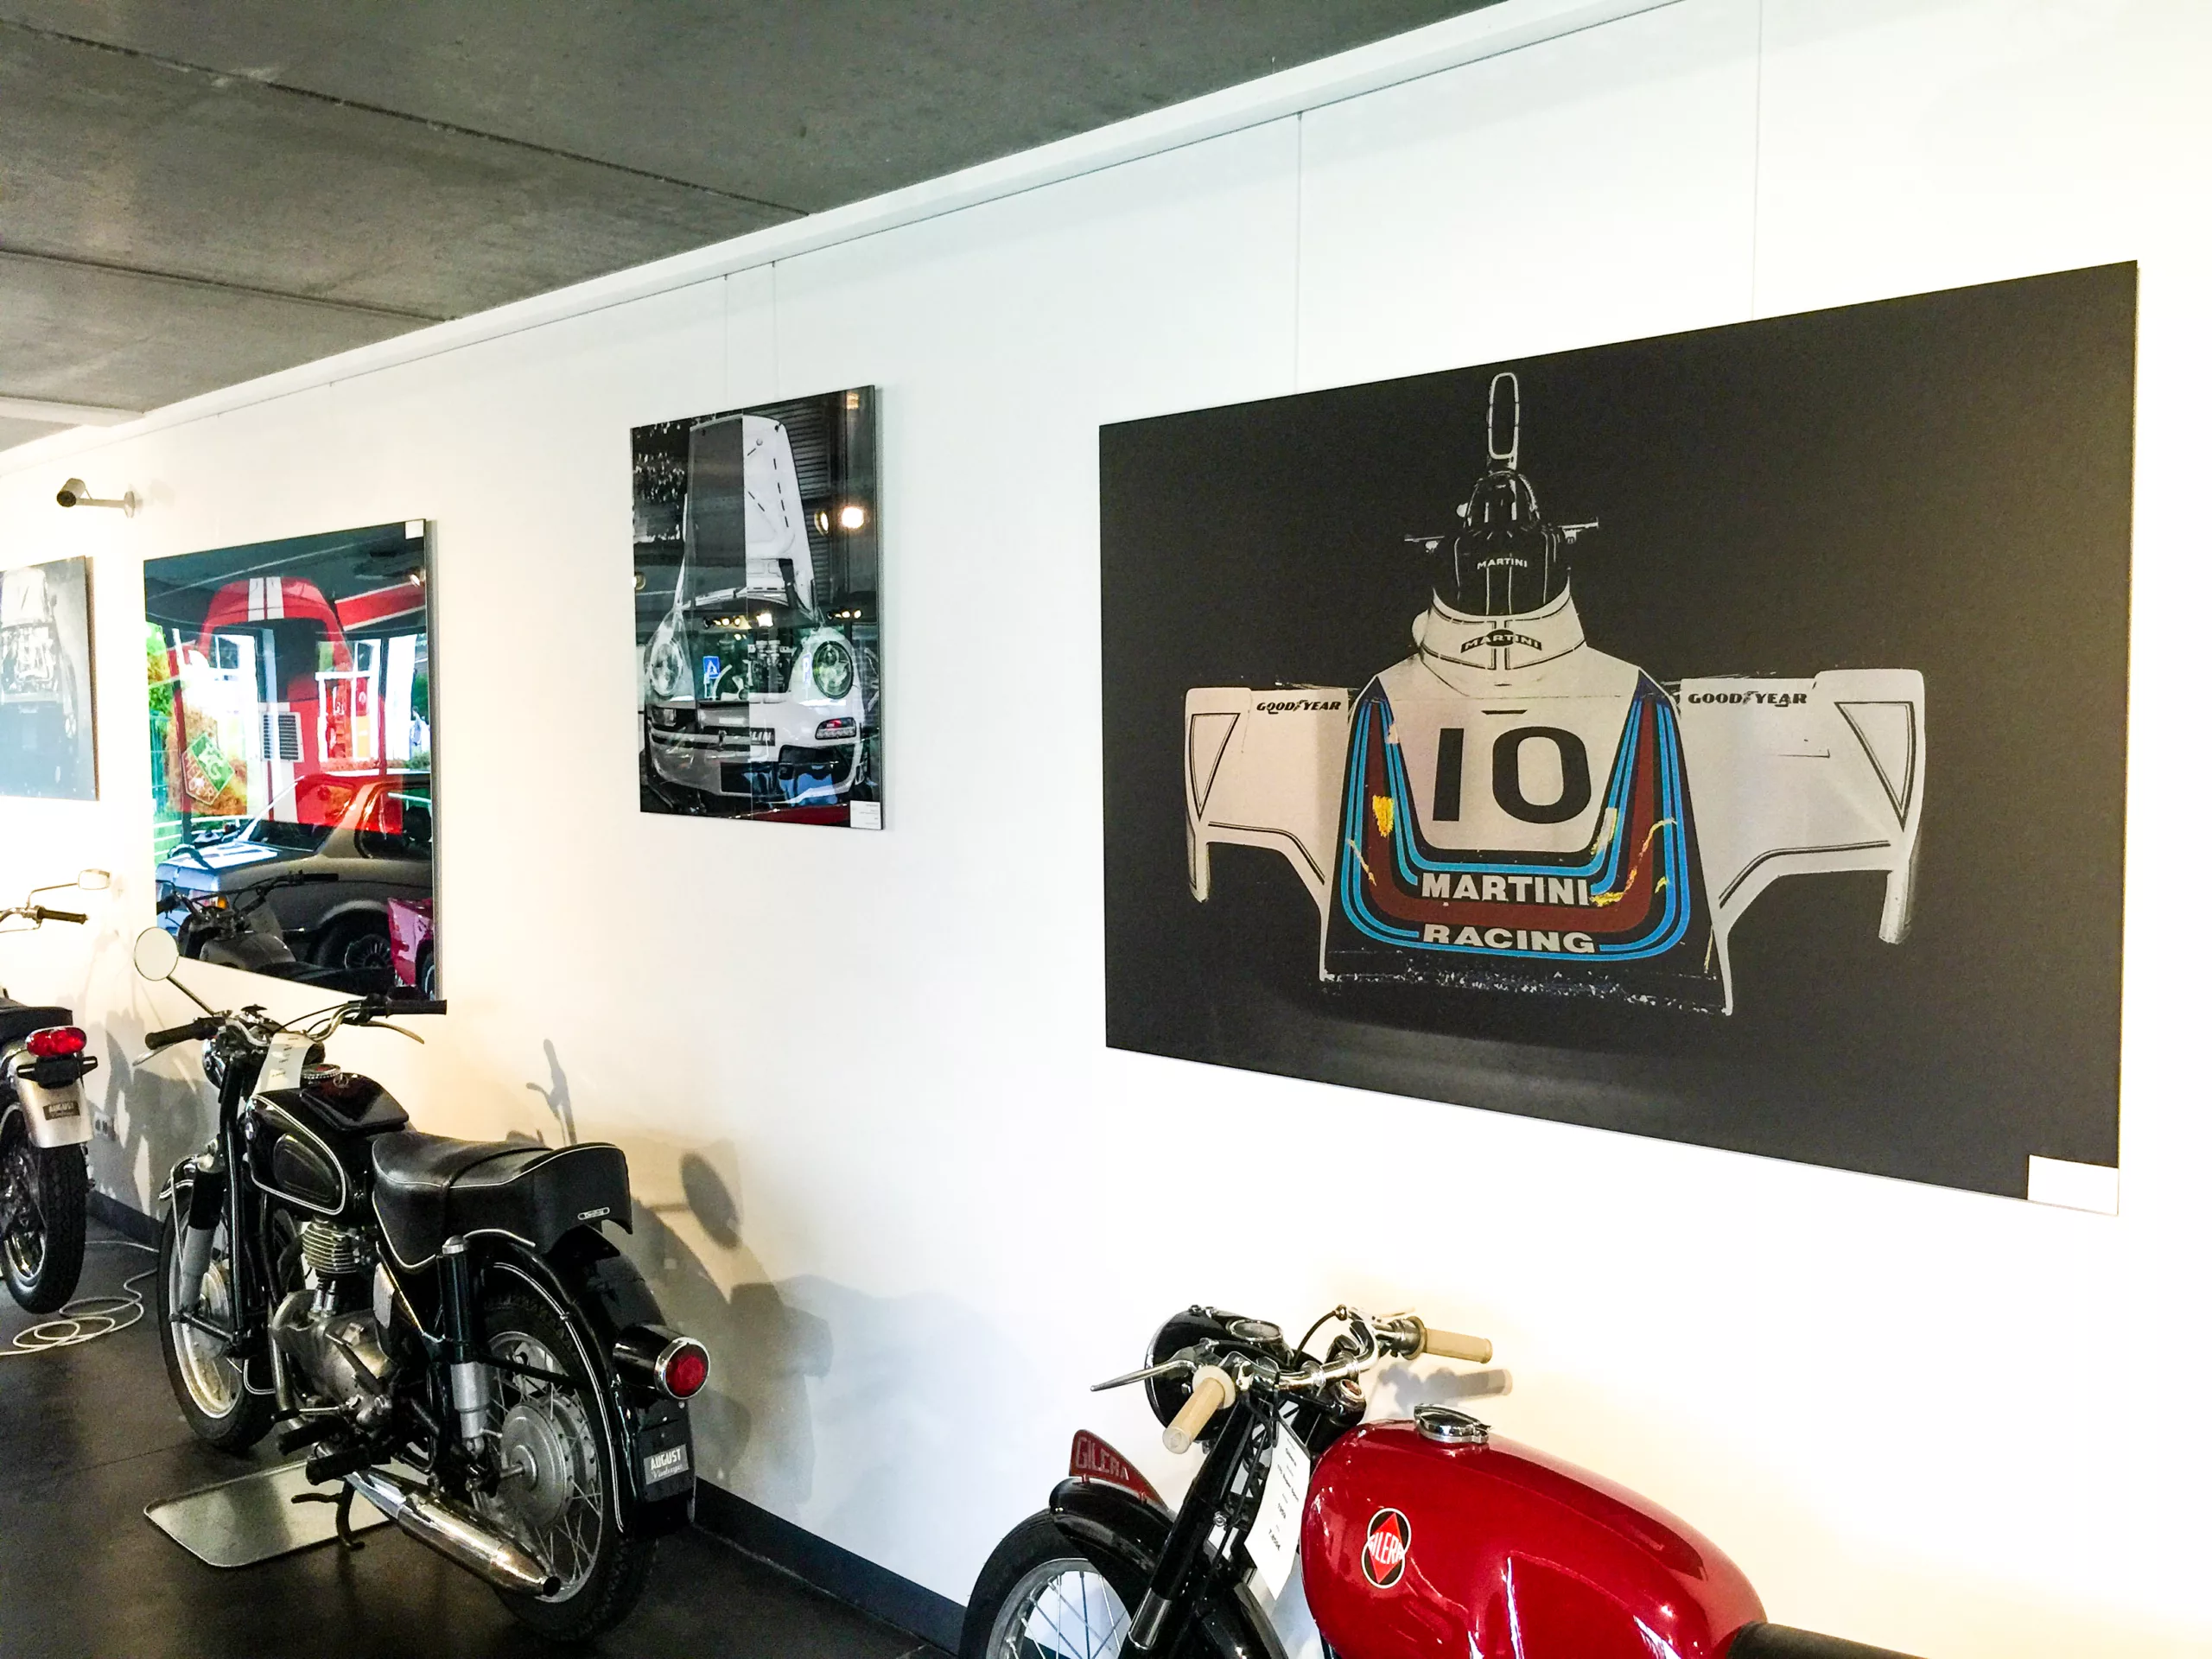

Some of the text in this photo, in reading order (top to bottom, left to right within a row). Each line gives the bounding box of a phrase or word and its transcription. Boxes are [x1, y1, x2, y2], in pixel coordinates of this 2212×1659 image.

[1477, 557, 1528, 570] MARTINI
[1462, 632, 1541, 652] MARTINI
[1433, 726, 1592, 824] 10
[1421, 872, 1590, 906] MARTINI
[1423, 923, 1595, 954] RACING
[651, 1448, 681, 1471] AUGUST
[1075, 1436, 1129, 1481] GILERA
[1367, 1531, 1406, 1565] GILERA
